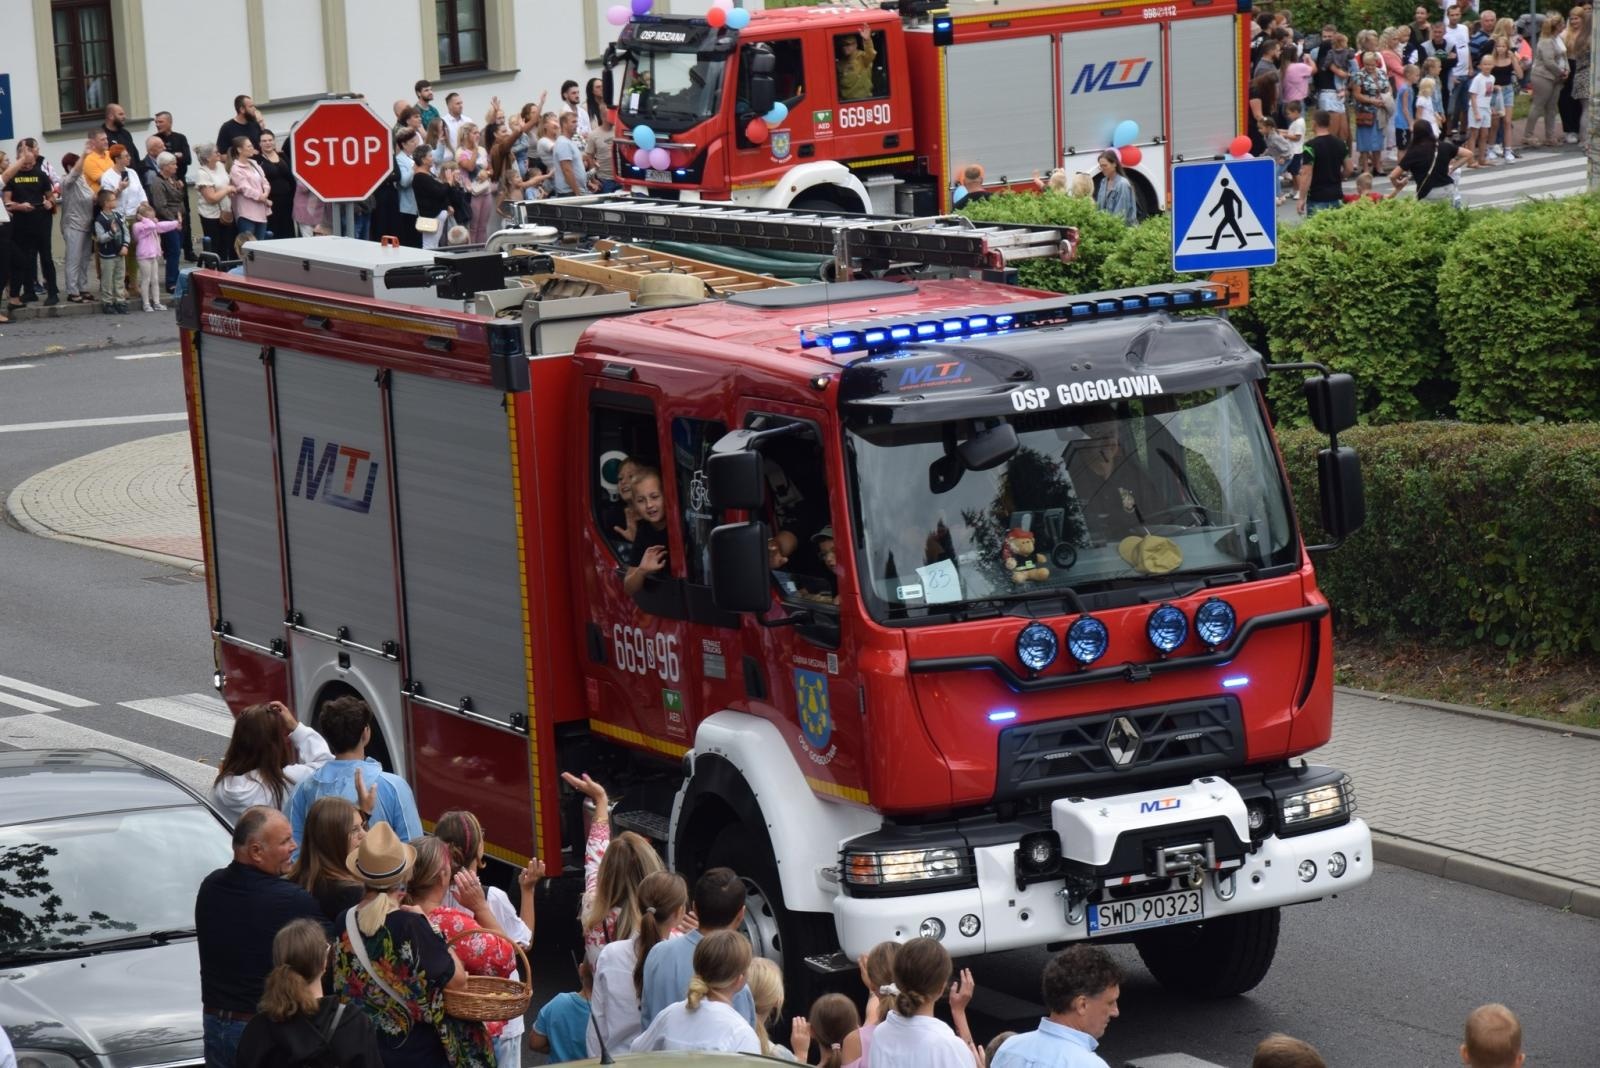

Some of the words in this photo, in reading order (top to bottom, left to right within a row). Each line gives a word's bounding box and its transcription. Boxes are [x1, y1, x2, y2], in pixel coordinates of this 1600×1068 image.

[303, 136, 381, 167] STOP
[1010, 387, 1051, 412] OSP
[1056, 374, 1164, 406] GOGOŁOWA
[1099, 902, 1136, 927] SWD
[1142, 892, 1200, 921] 90323
